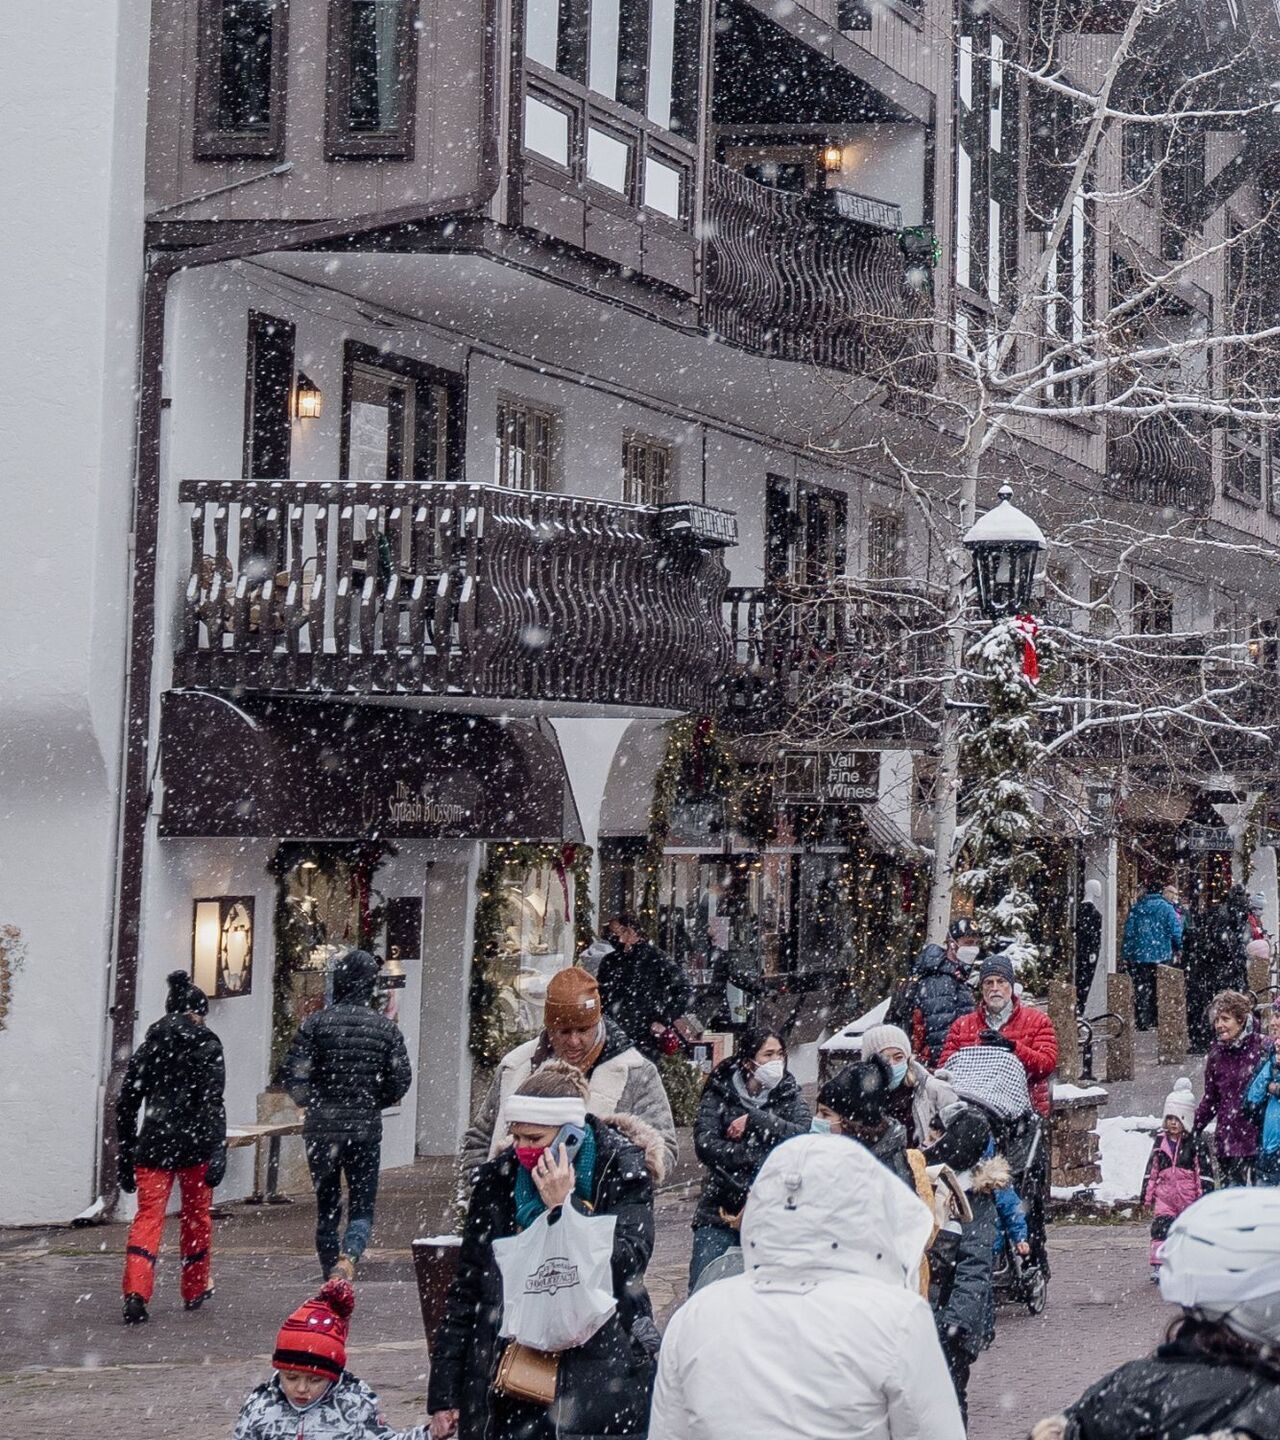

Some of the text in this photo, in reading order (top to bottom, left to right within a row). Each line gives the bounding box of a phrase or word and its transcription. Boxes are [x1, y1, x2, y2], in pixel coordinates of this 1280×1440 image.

[829, 753, 856, 767] Vail
[829, 769, 860, 782] Fine
[828, 784, 875, 798] Wines
[388, 794, 462, 828] Squash Blossom
